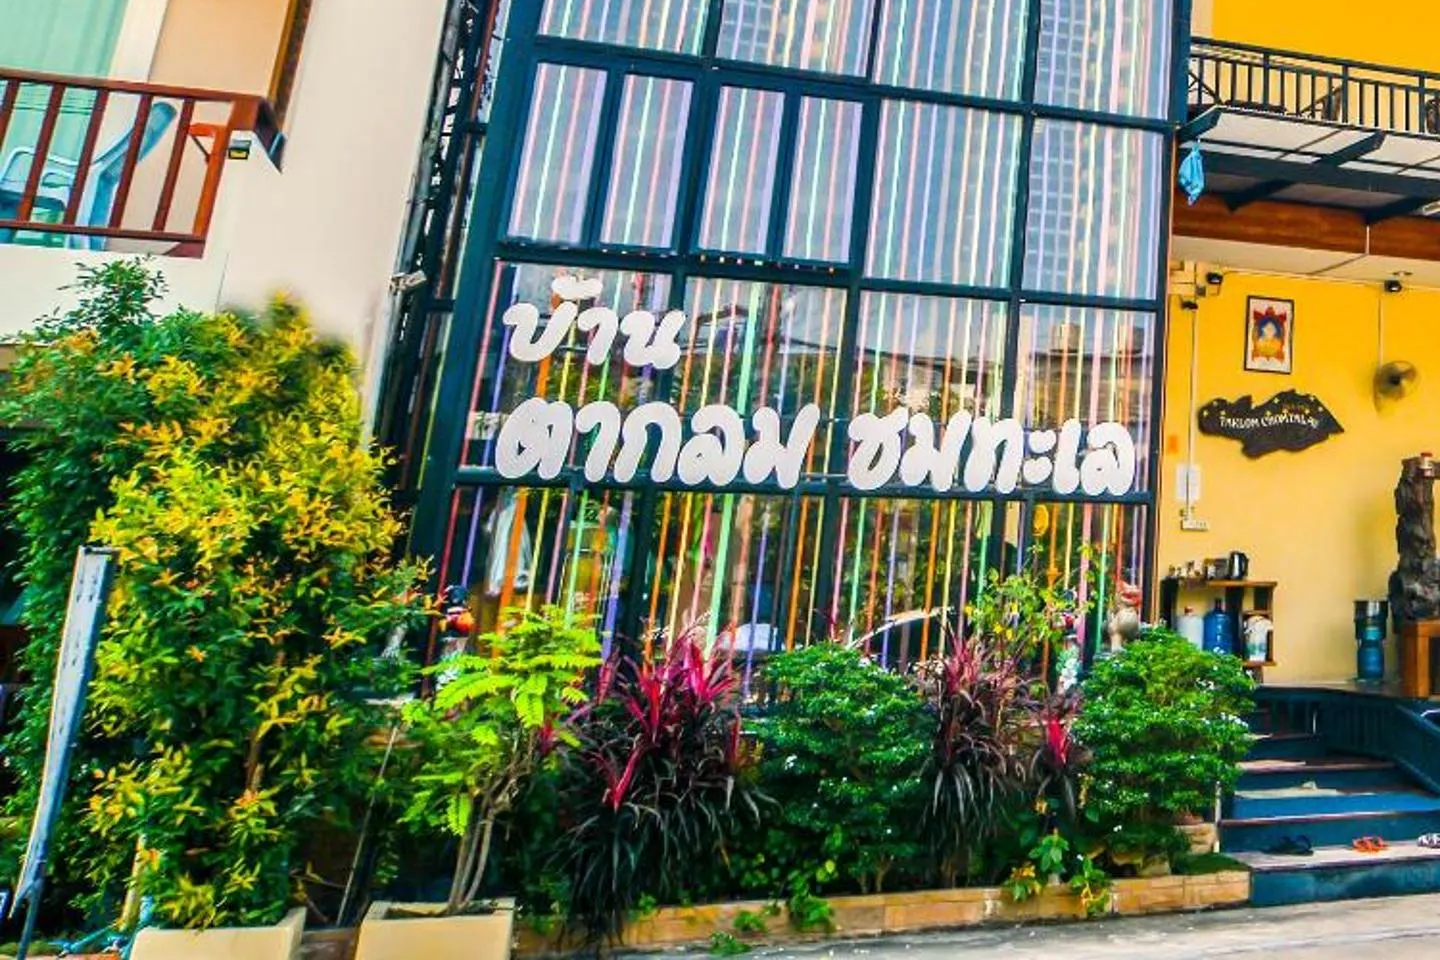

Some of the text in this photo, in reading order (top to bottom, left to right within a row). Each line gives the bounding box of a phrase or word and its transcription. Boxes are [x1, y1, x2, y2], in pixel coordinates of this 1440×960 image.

[502, 276, 687, 370] บ้าน
[495, 396, 1136, 496] ตากลม ชมทะเล
